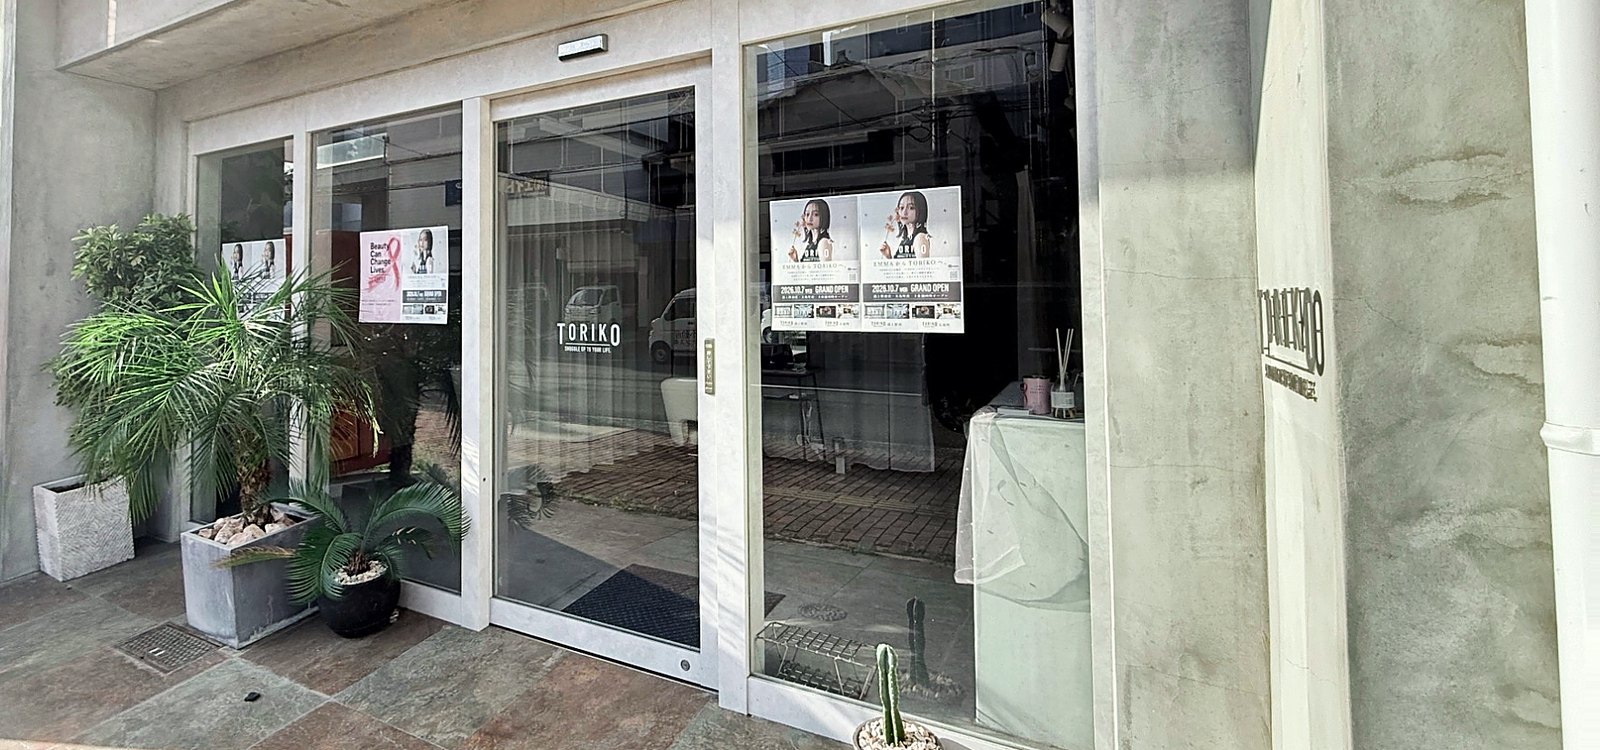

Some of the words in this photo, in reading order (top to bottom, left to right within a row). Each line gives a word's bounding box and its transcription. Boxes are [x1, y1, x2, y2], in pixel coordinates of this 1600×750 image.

[370, 243, 390, 252] Beauty
[910, 284, 932, 292] GRAND
[933, 284, 950, 292] OPEN
[557, 322, 620, 346] TORIKO
